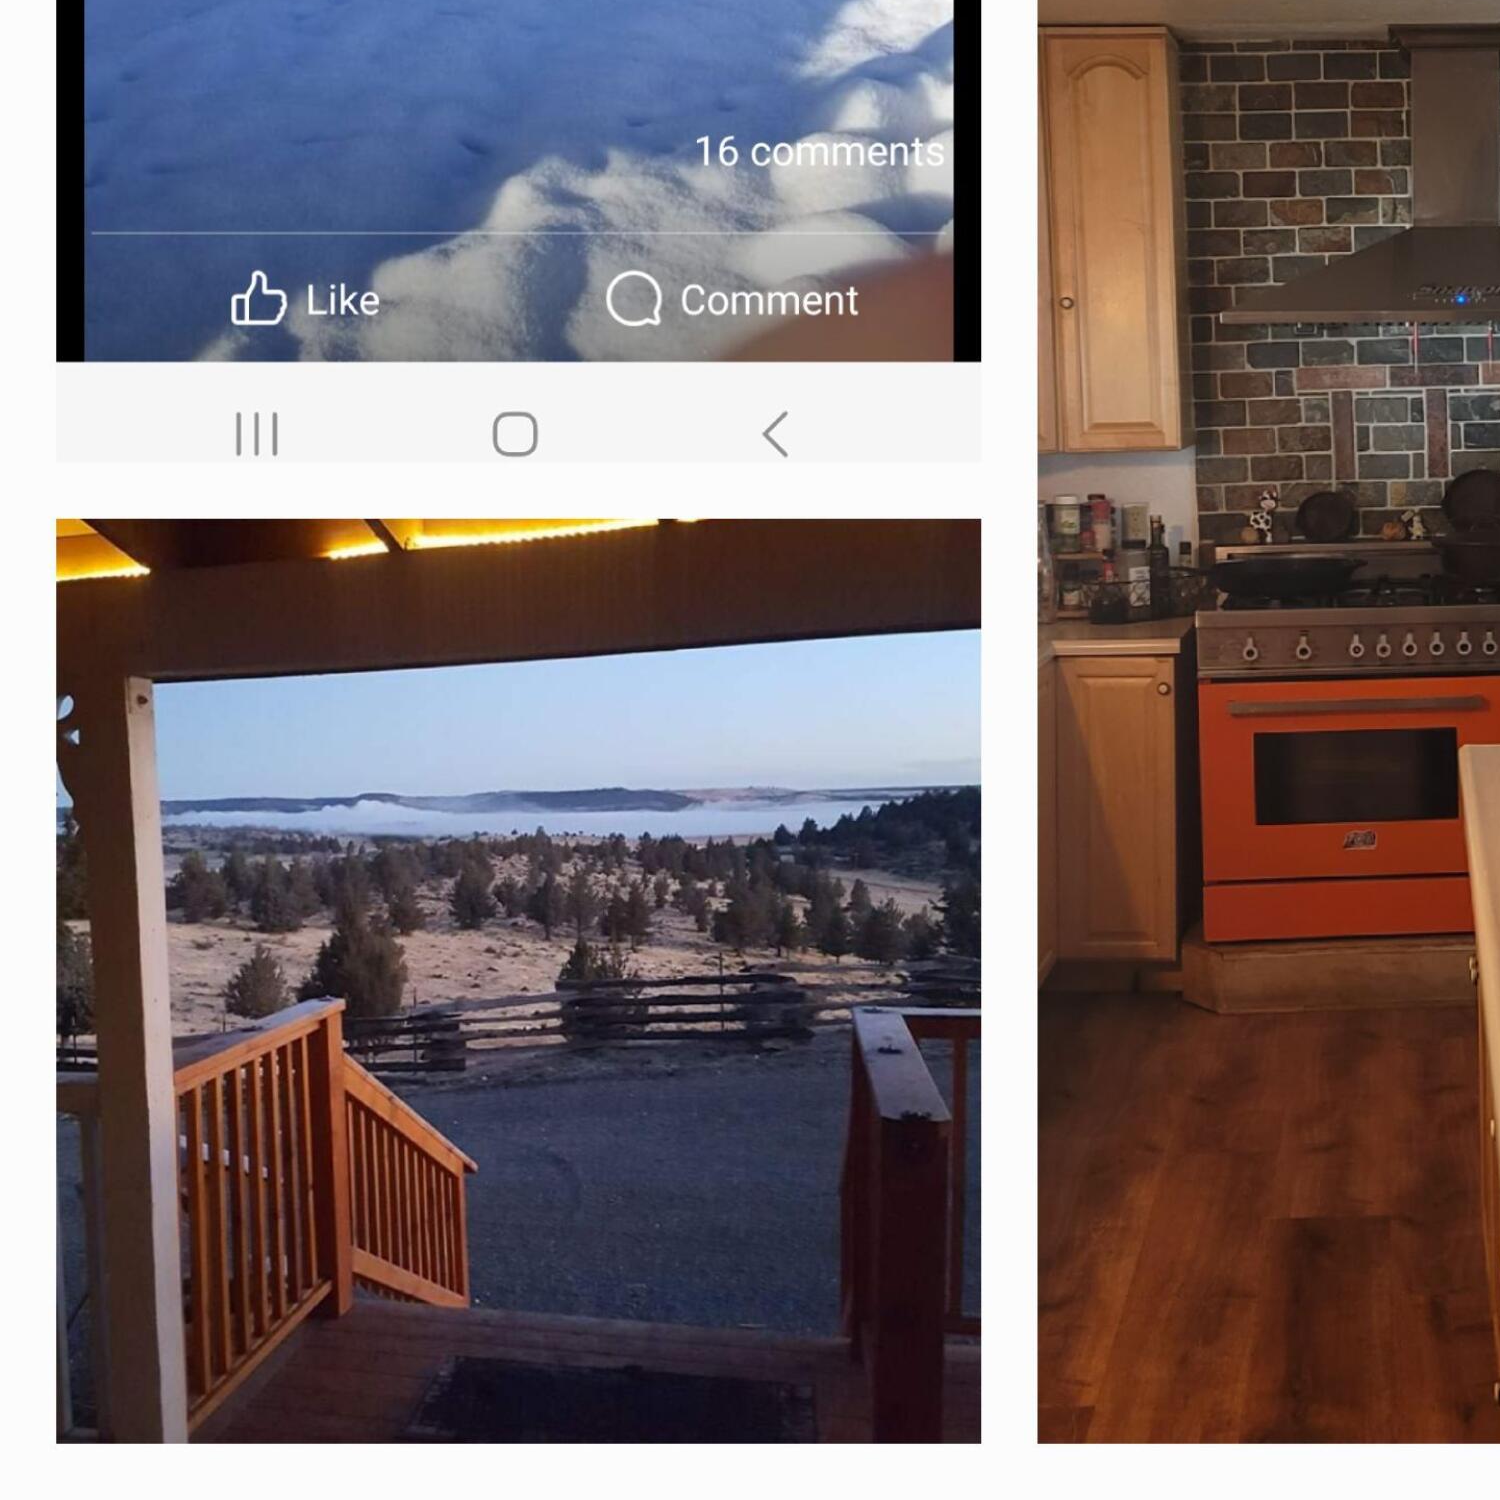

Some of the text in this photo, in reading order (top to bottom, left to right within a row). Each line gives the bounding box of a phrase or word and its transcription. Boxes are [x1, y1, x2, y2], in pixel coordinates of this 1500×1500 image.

[697, 136, 945, 168] 16 comments
[307, 284, 380, 317] Like
[681, 284, 860, 317] Comment
